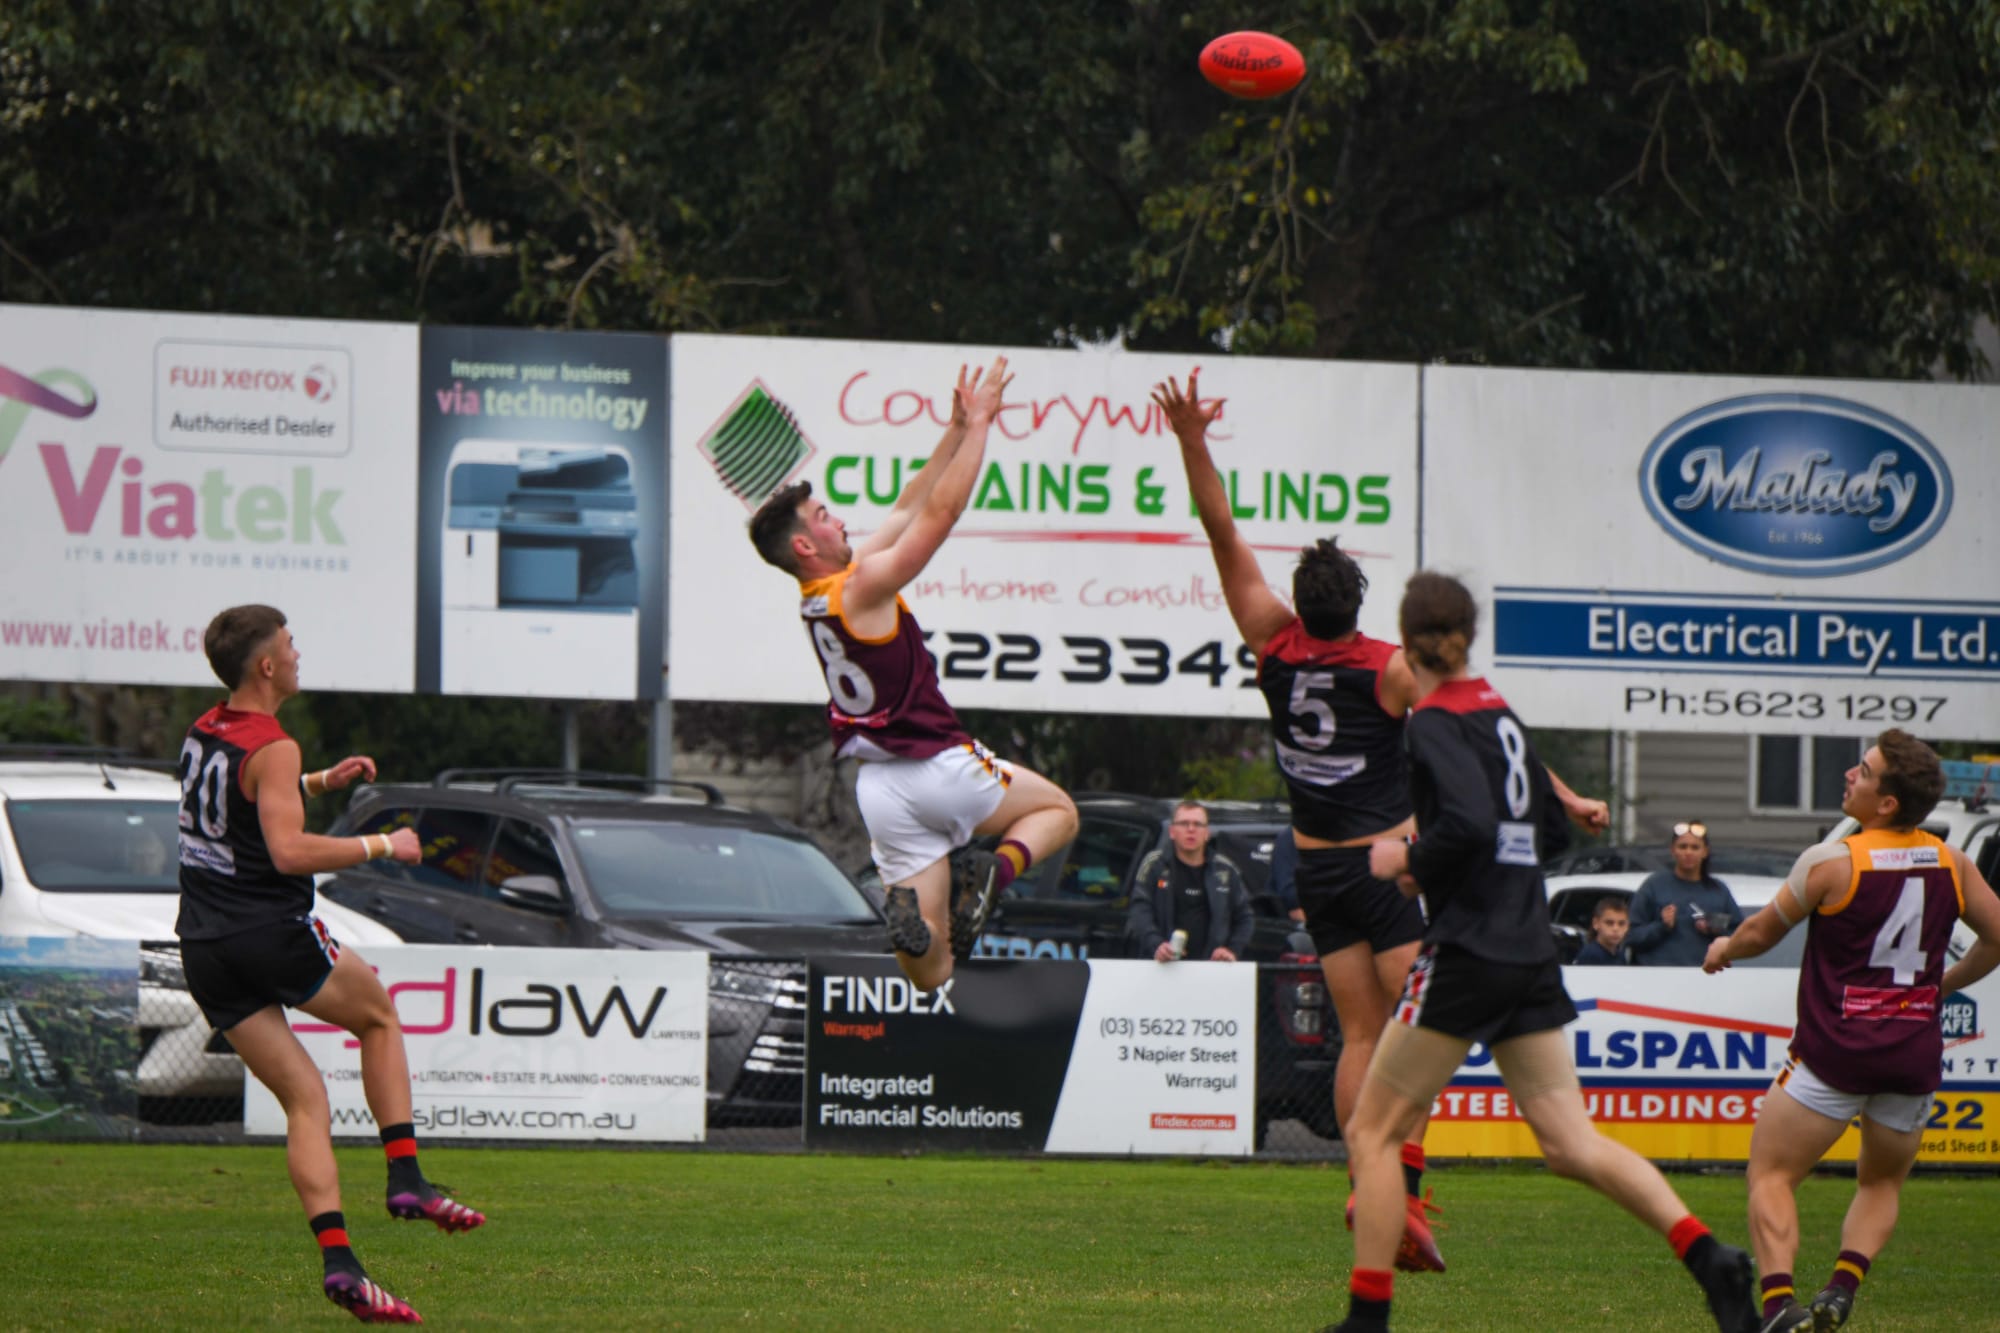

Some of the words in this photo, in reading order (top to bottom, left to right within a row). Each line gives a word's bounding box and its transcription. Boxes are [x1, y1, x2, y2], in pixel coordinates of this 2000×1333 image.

[170, 366, 216, 387] FUJI
[222, 368, 295, 391] xerox
[451, 359, 516, 380] Improve
[520, 365, 557, 382] your
[561, 362, 632, 384] business
[436, 381, 480, 415] via
[484, 385, 648, 431] technology
[170, 411, 270, 435] Authorised
[275, 417, 335, 437] Dealer
[37, 443, 347, 546] Viatek
[825, 456, 1111, 514] CUAINS
[1134, 466, 1166, 517] &
[1190, 469, 1391, 525] LINDS
[1673, 445, 1918, 534] Malady
[114, 551, 180, 565] ABOUT
[189, 553, 241, 567] YOUR
[251, 555, 350, 572] BUSINESS
[1588, 607, 1798, 658] Electrical
[1817, 614, 1897, 675] Pty.
[1912, 615, 1998, 662] Ltd.
[813, 620, 876, 716] 8
[1288, 671, 1336, 751] 5
[1838, 695, 1948, 724] 1297
[1496, 716, 1531, 819] 8
[179, 736, 229, 839] 20
[1868, 877, 1928, 985] 4
[823, 976, 955, 1014] FINDEX
[1942, 1003, 1973, 1018] HED
[651, 1030, 701, 1041] LAWYERS
[823, 1021, 885, 1040] Warragul
[1100, 1017, 1134, 1038] (03)
[1139, 1018, 1185, 1036] 5622
[1192, 1020, 1238, 1036] 7500
[1942, 1019, 1972, 1034] AFE
[1118, 1046, 1129, 1061] 3
[1133, 1047, 1185, 1064] Napier
[1190, 1046, 1238, 1062] Street
[1464, 1030, 1767, 1070] LSPAN
[420, 1071, 483, 1083] LITIGATION
[493, 1072, 536, 1084] ESTATE
[540, 1073, 599, 1085] PLANNING
[608, 1074, 701, 1087] CONVEYANCING
[820, 1073, 934, 1098] Integrated
[1166, 1073, 1238, 1092] Warragul
[820, 1104, 917, 1126] Financial
[922, 1105, 1023, 1127] Solutions
[1154, 1115, 1233, 1129] findex.com.au
[1921, 1139, 1946, 1152] red
[1950, 1139, 1987, 1153] Shed
